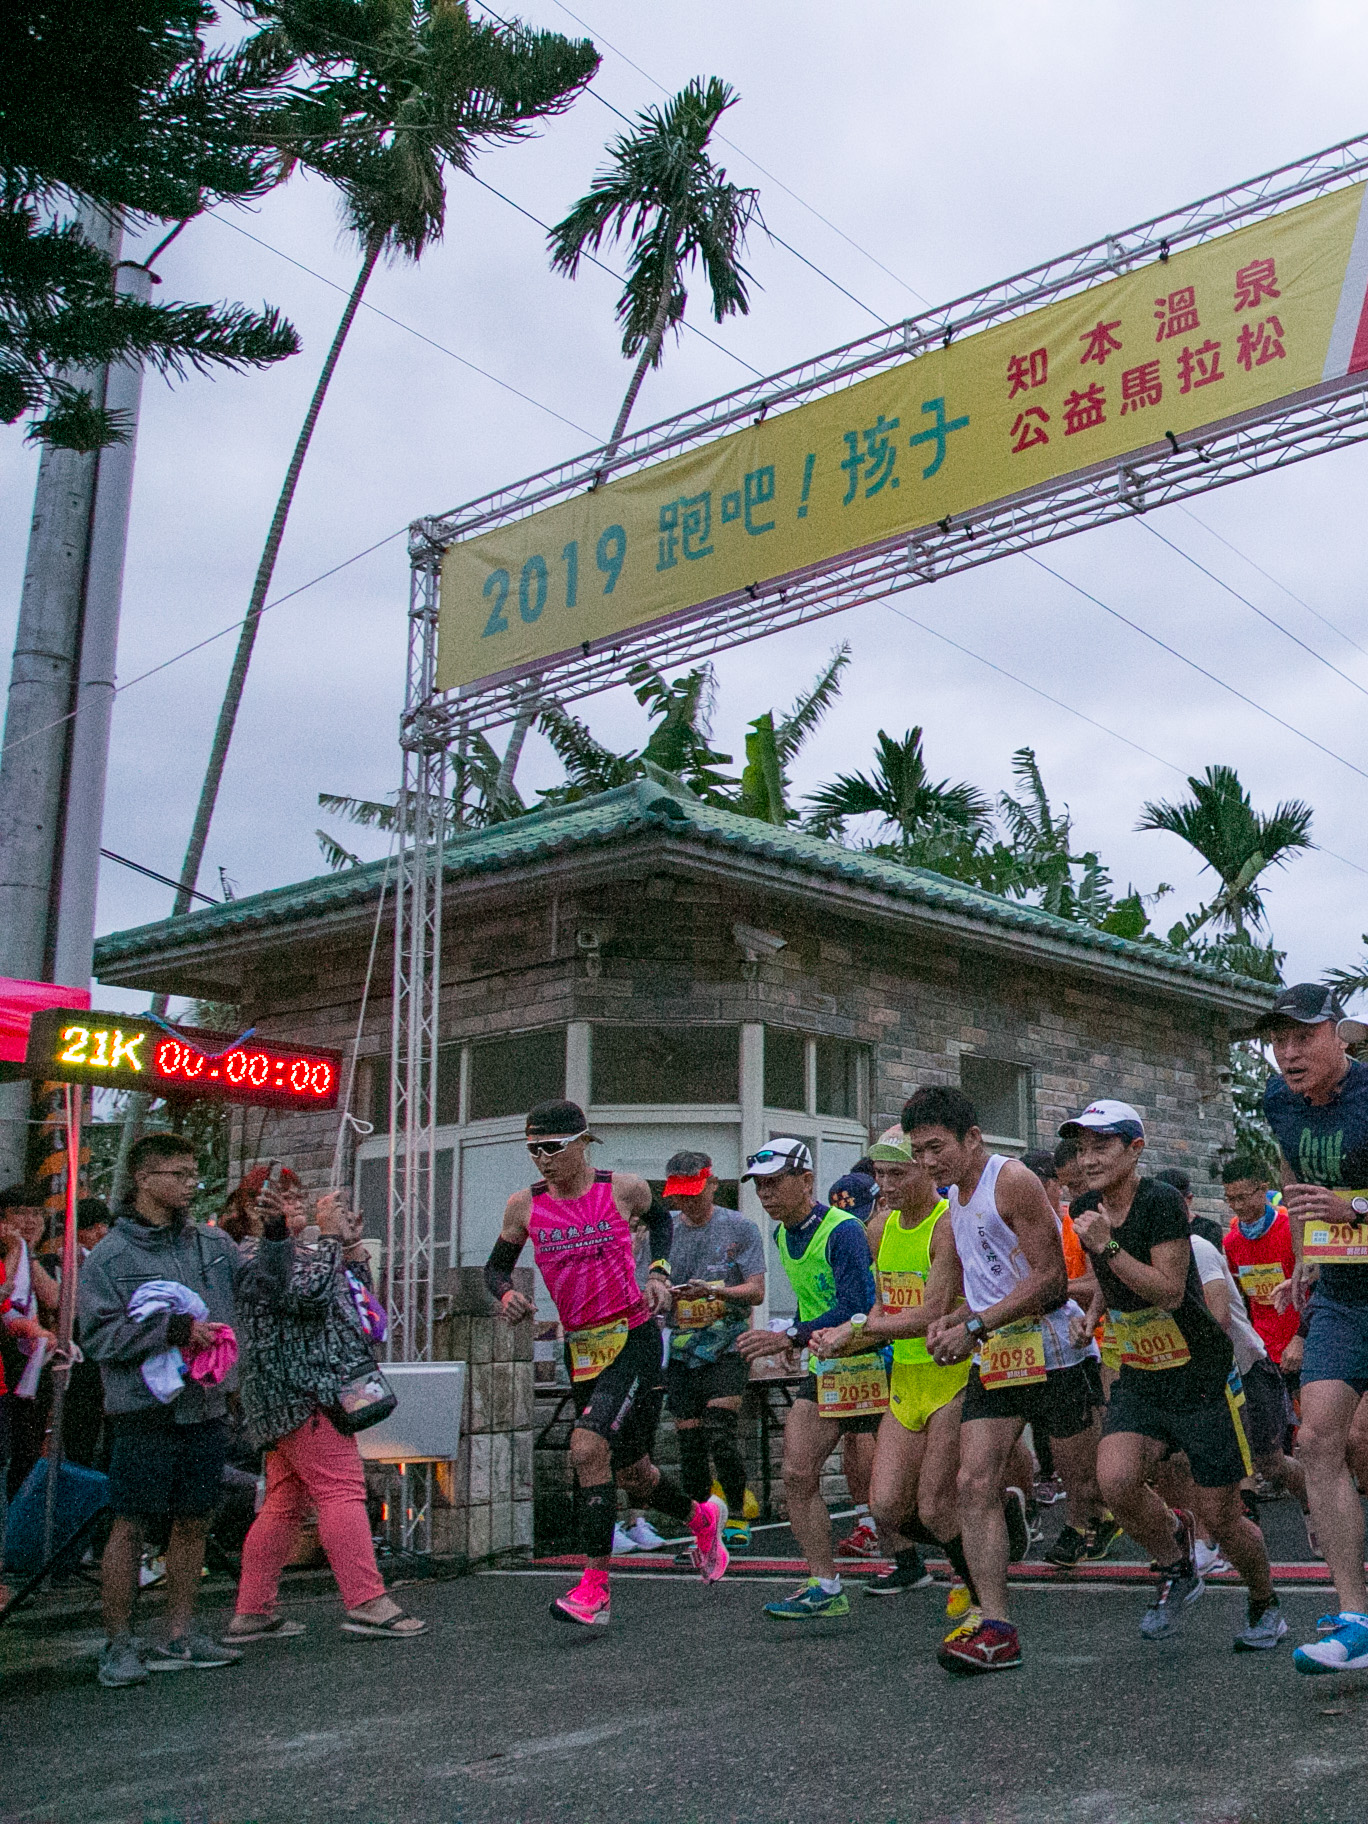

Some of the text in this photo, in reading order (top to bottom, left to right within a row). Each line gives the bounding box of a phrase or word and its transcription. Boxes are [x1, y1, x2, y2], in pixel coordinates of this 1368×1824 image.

[1008, 256, 1281, 400] 知本溫泉
[1011, 316, 1288, 454] 公益馬拉松
[481, 525, 627, 638] 2019
[62, 1027, 145, 1070] 21K
[890, 1288, 921, 1305] 2071
[990, 1347, 1036, 1371] 2098
[839, 1382, 881, 1402] 2058
